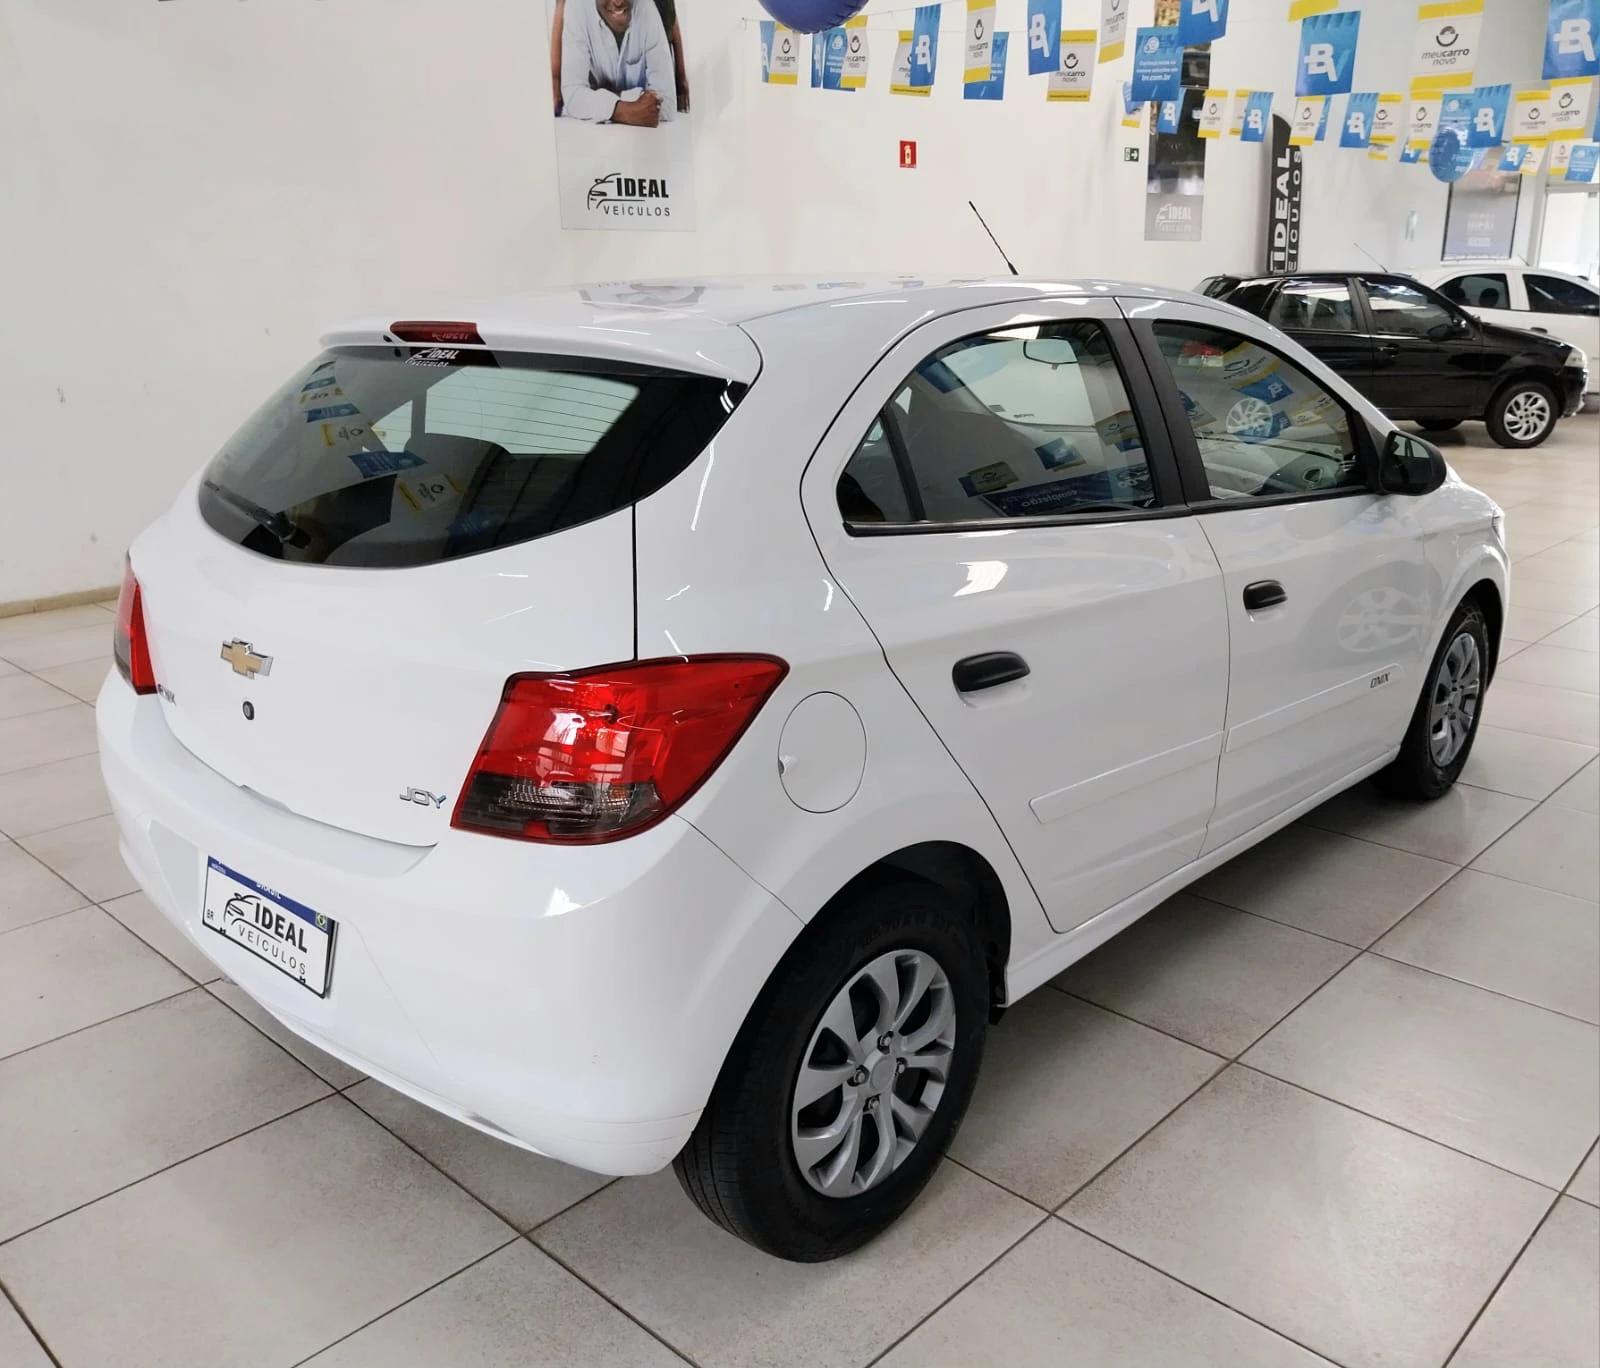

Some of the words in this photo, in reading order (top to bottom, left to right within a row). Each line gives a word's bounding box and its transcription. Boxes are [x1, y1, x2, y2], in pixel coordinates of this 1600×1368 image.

[616, 177, 669, 198] IDEAL
[1168, 206, 1192, 220] IDEAL
[1274, 147, 1291, 262] IDEAL
[427, 349, 460, 360] IDEAL
[399, 786, 447, 809] JOY
[254, 902, 308, 954] IDEAL
